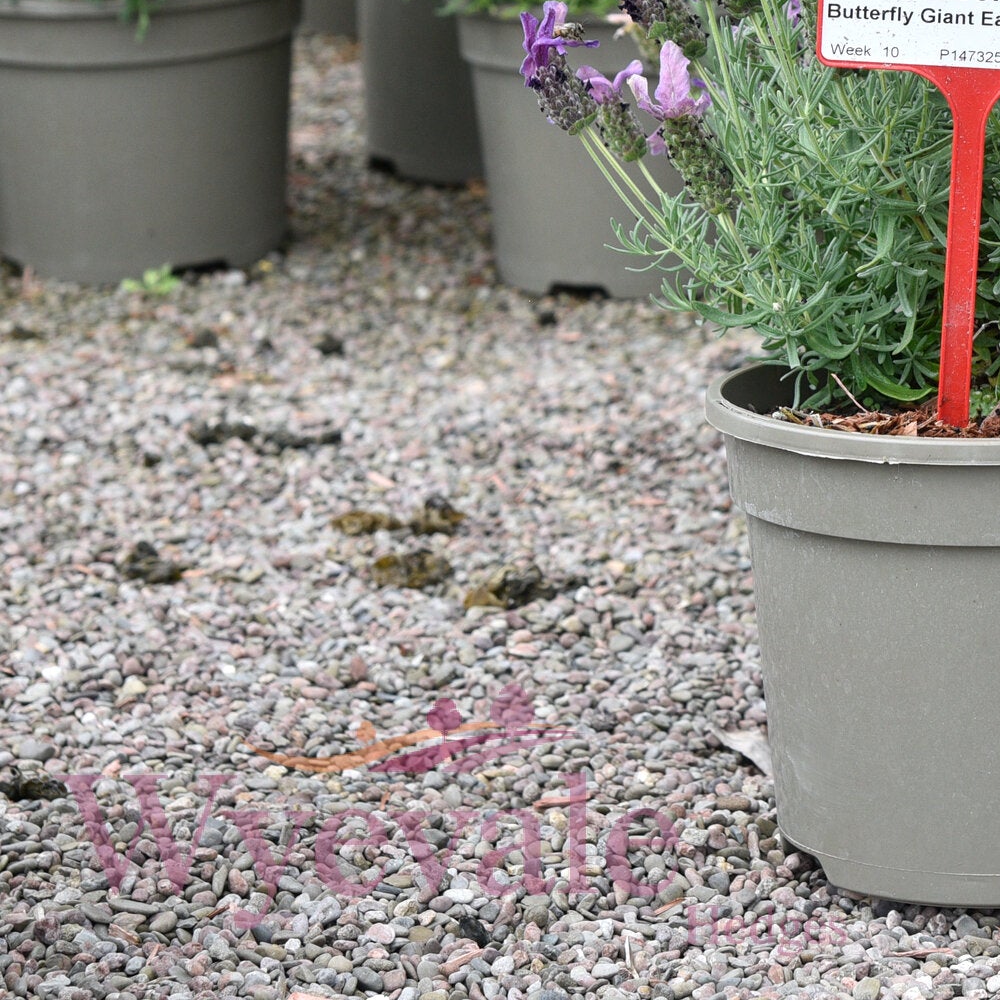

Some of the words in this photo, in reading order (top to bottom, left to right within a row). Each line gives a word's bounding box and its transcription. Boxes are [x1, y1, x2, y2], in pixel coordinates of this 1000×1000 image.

[827, 4, 914, 26] Butterfly
[921, 7, 975, 26] Giant
[830, 43, 871, 57] Week
[884, 46, 899, 58] 10
